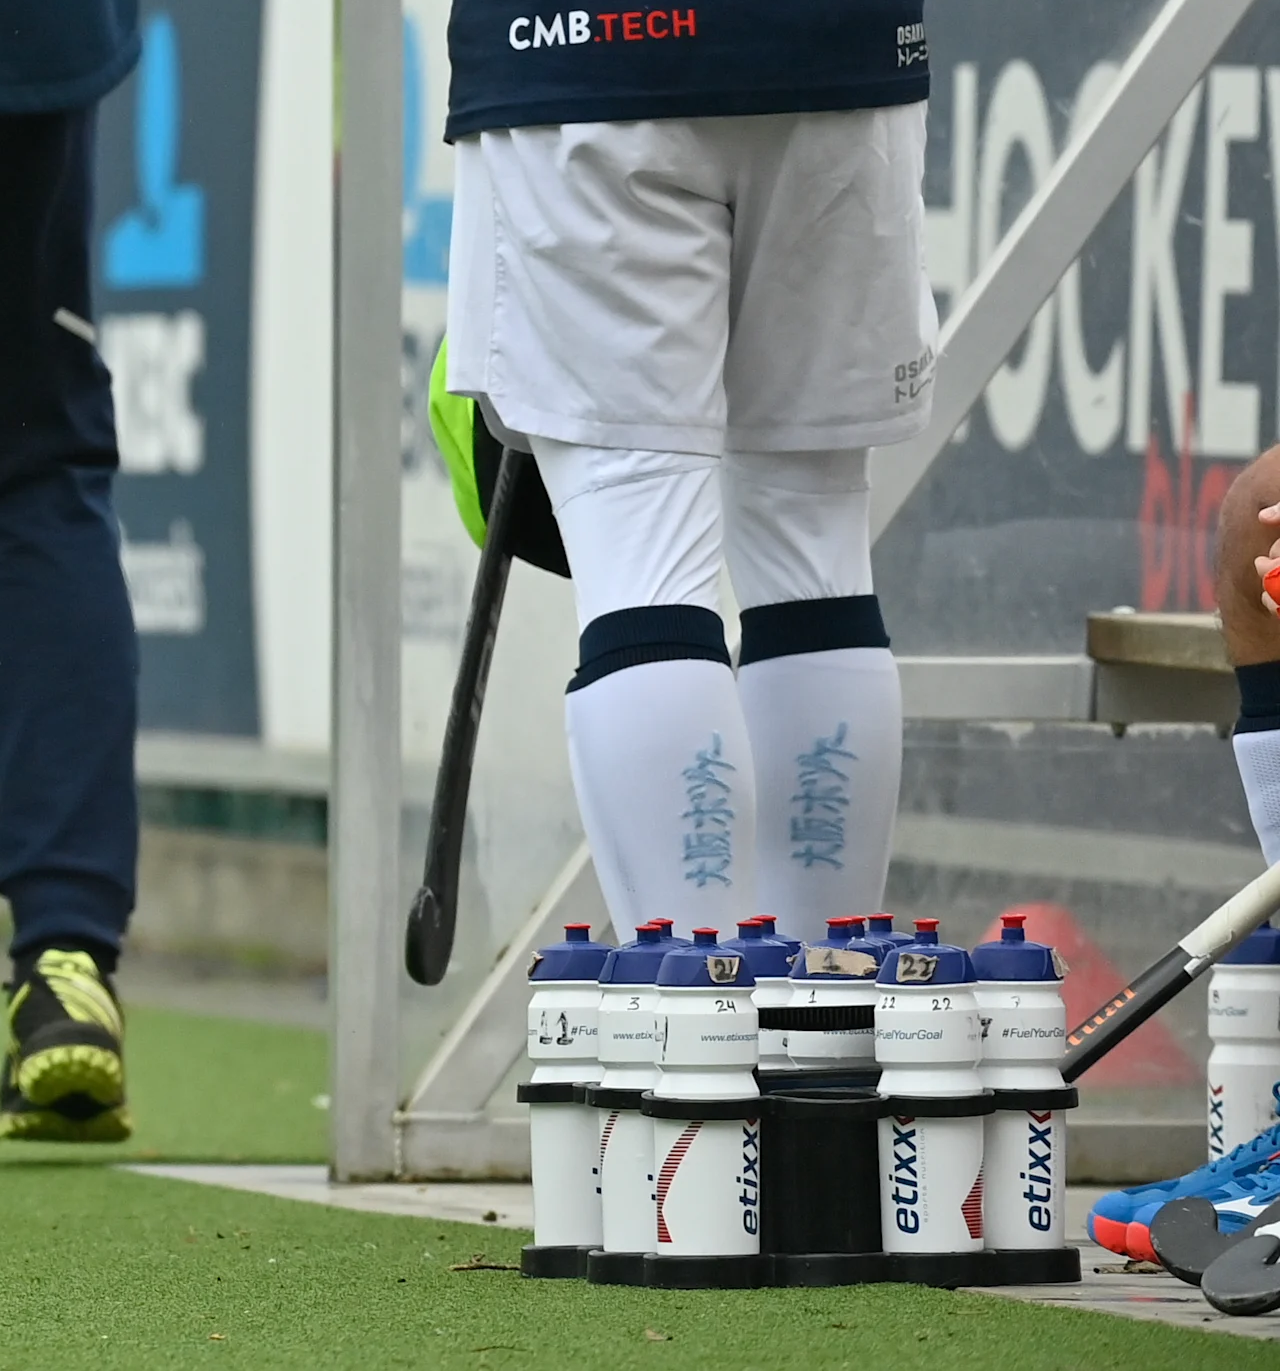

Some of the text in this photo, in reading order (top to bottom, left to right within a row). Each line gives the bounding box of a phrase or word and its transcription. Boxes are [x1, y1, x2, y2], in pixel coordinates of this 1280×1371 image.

[508, 9, 697, 51] CMB.TECH
[924, 59, 1280, 454] HOCKE
[627, 997, 640, 1011] 3
[715, 999, 736, 1014] 24
[931, 997, 953, 1011] 22
[736, 1125, 758, 1236] etixx
[888, 1123, 920, 1234] etixx
[1020, 1121, 1052, 1232] etixx
